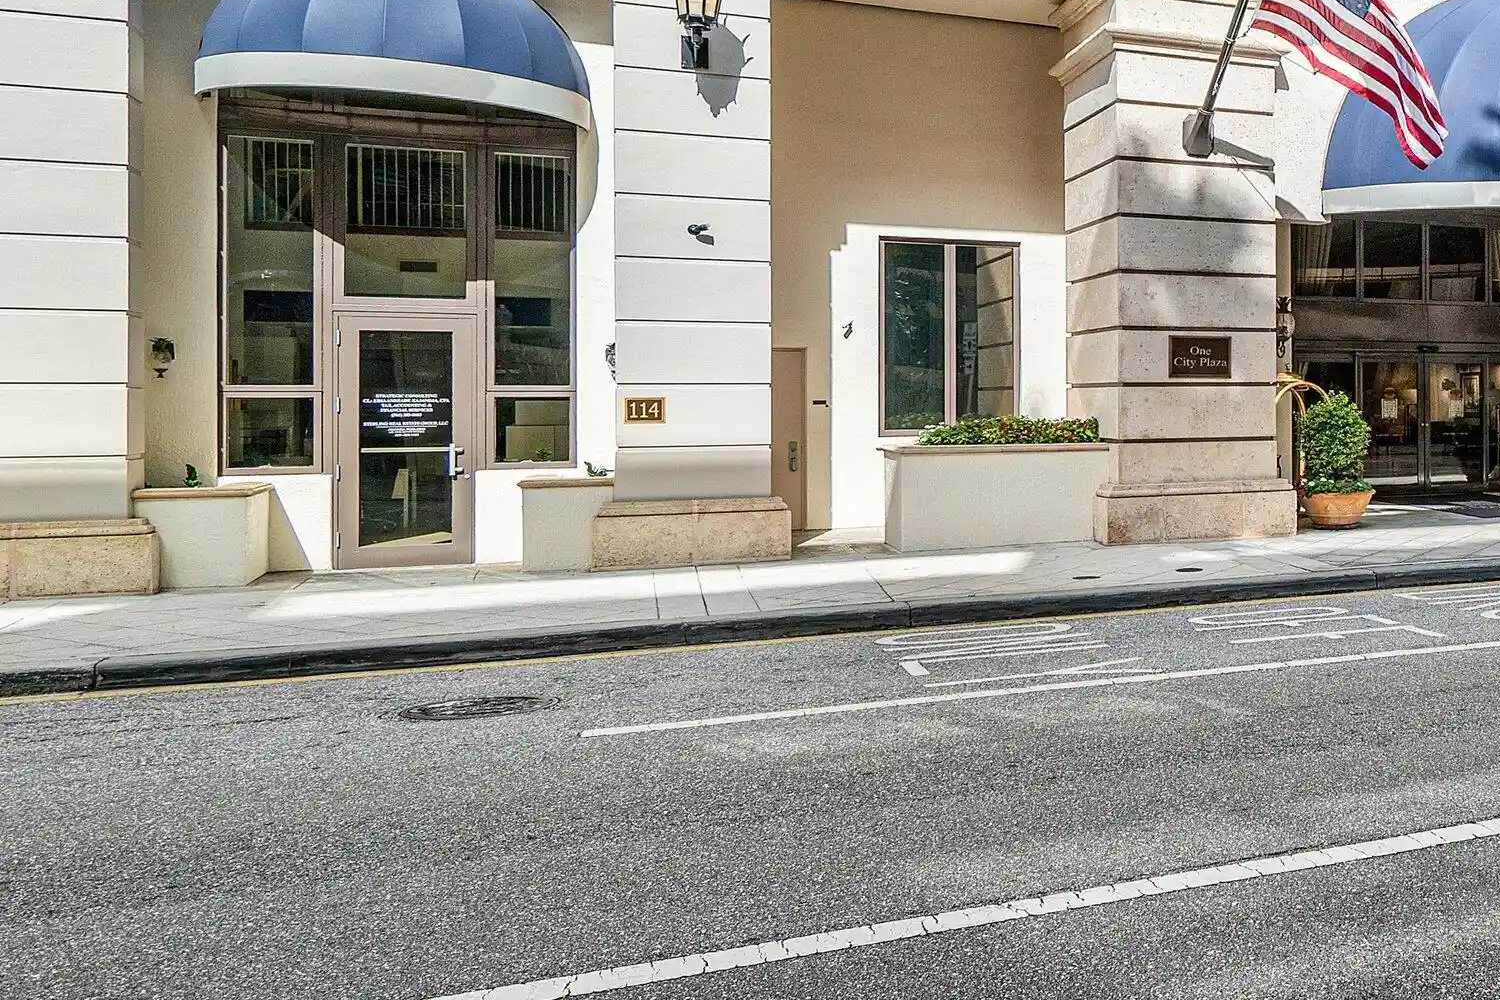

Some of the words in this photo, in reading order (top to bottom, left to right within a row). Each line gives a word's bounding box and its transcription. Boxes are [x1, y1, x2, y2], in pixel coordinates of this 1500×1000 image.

[1190, 345, 1212, 356] One
[1173, 356, 1197, 369] City
[1199, 357, 1228, 367] Plaza
[629, 401, 660, 418] 114
[1187, 606, 1447, 644] OFF
[872, 622, 1164, 688] ONLY
